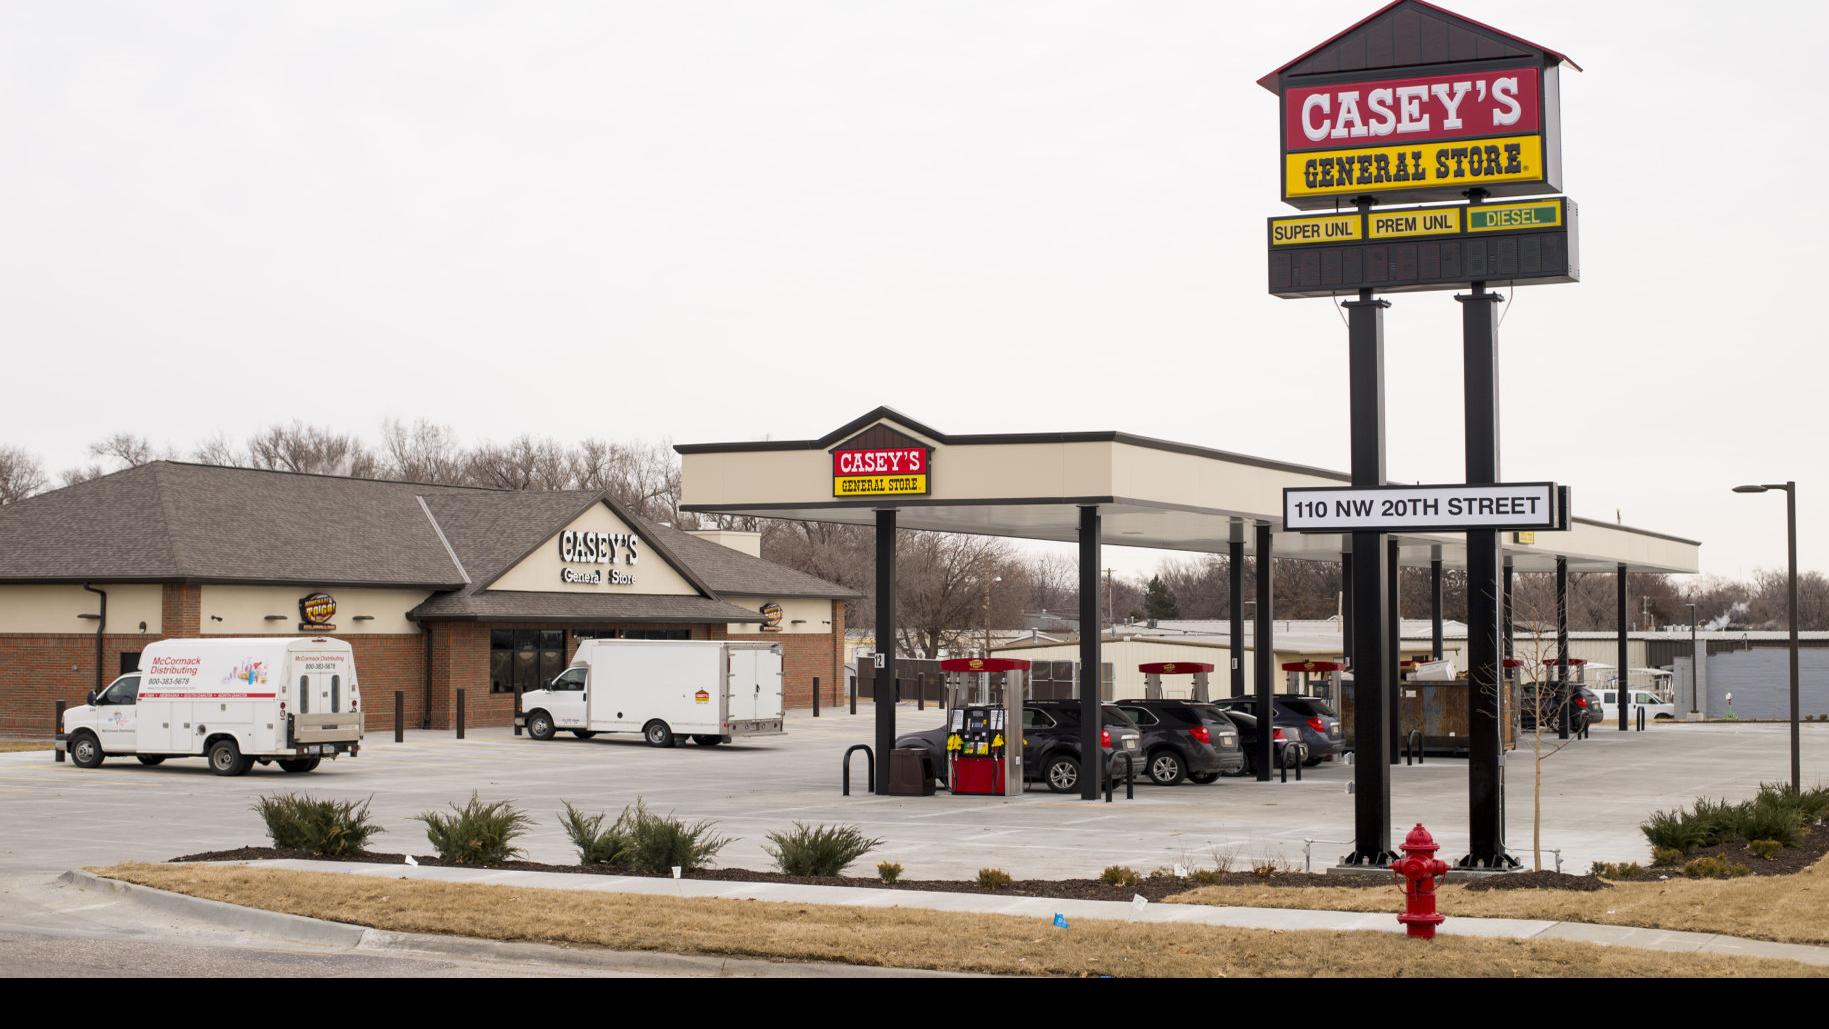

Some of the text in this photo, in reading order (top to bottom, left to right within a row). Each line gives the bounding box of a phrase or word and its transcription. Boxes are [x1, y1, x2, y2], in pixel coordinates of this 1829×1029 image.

[1302, 77, 1522, 142] CASEY'S
[1304, 143, 1521, 189] GENERAL STORE
[1376, 214, 1453, 234] PREM UNL
[1486, 209, 1541, 226] DIESEL
[1274, 222, 1353, 241] SUPER UNL
[840, 451, 920, 473] CASEY'S
[842, 478, 918, 492] GENERAL STORE
[1294, 496, 1541, 519] 110 NW 20TH STREET
[561, 530, 639, 565] CASEY'S
[611, 569, 637, 584] Store
[152, 657, 202, 665] McCormack
[150, 666, 198, 676] Distributing
